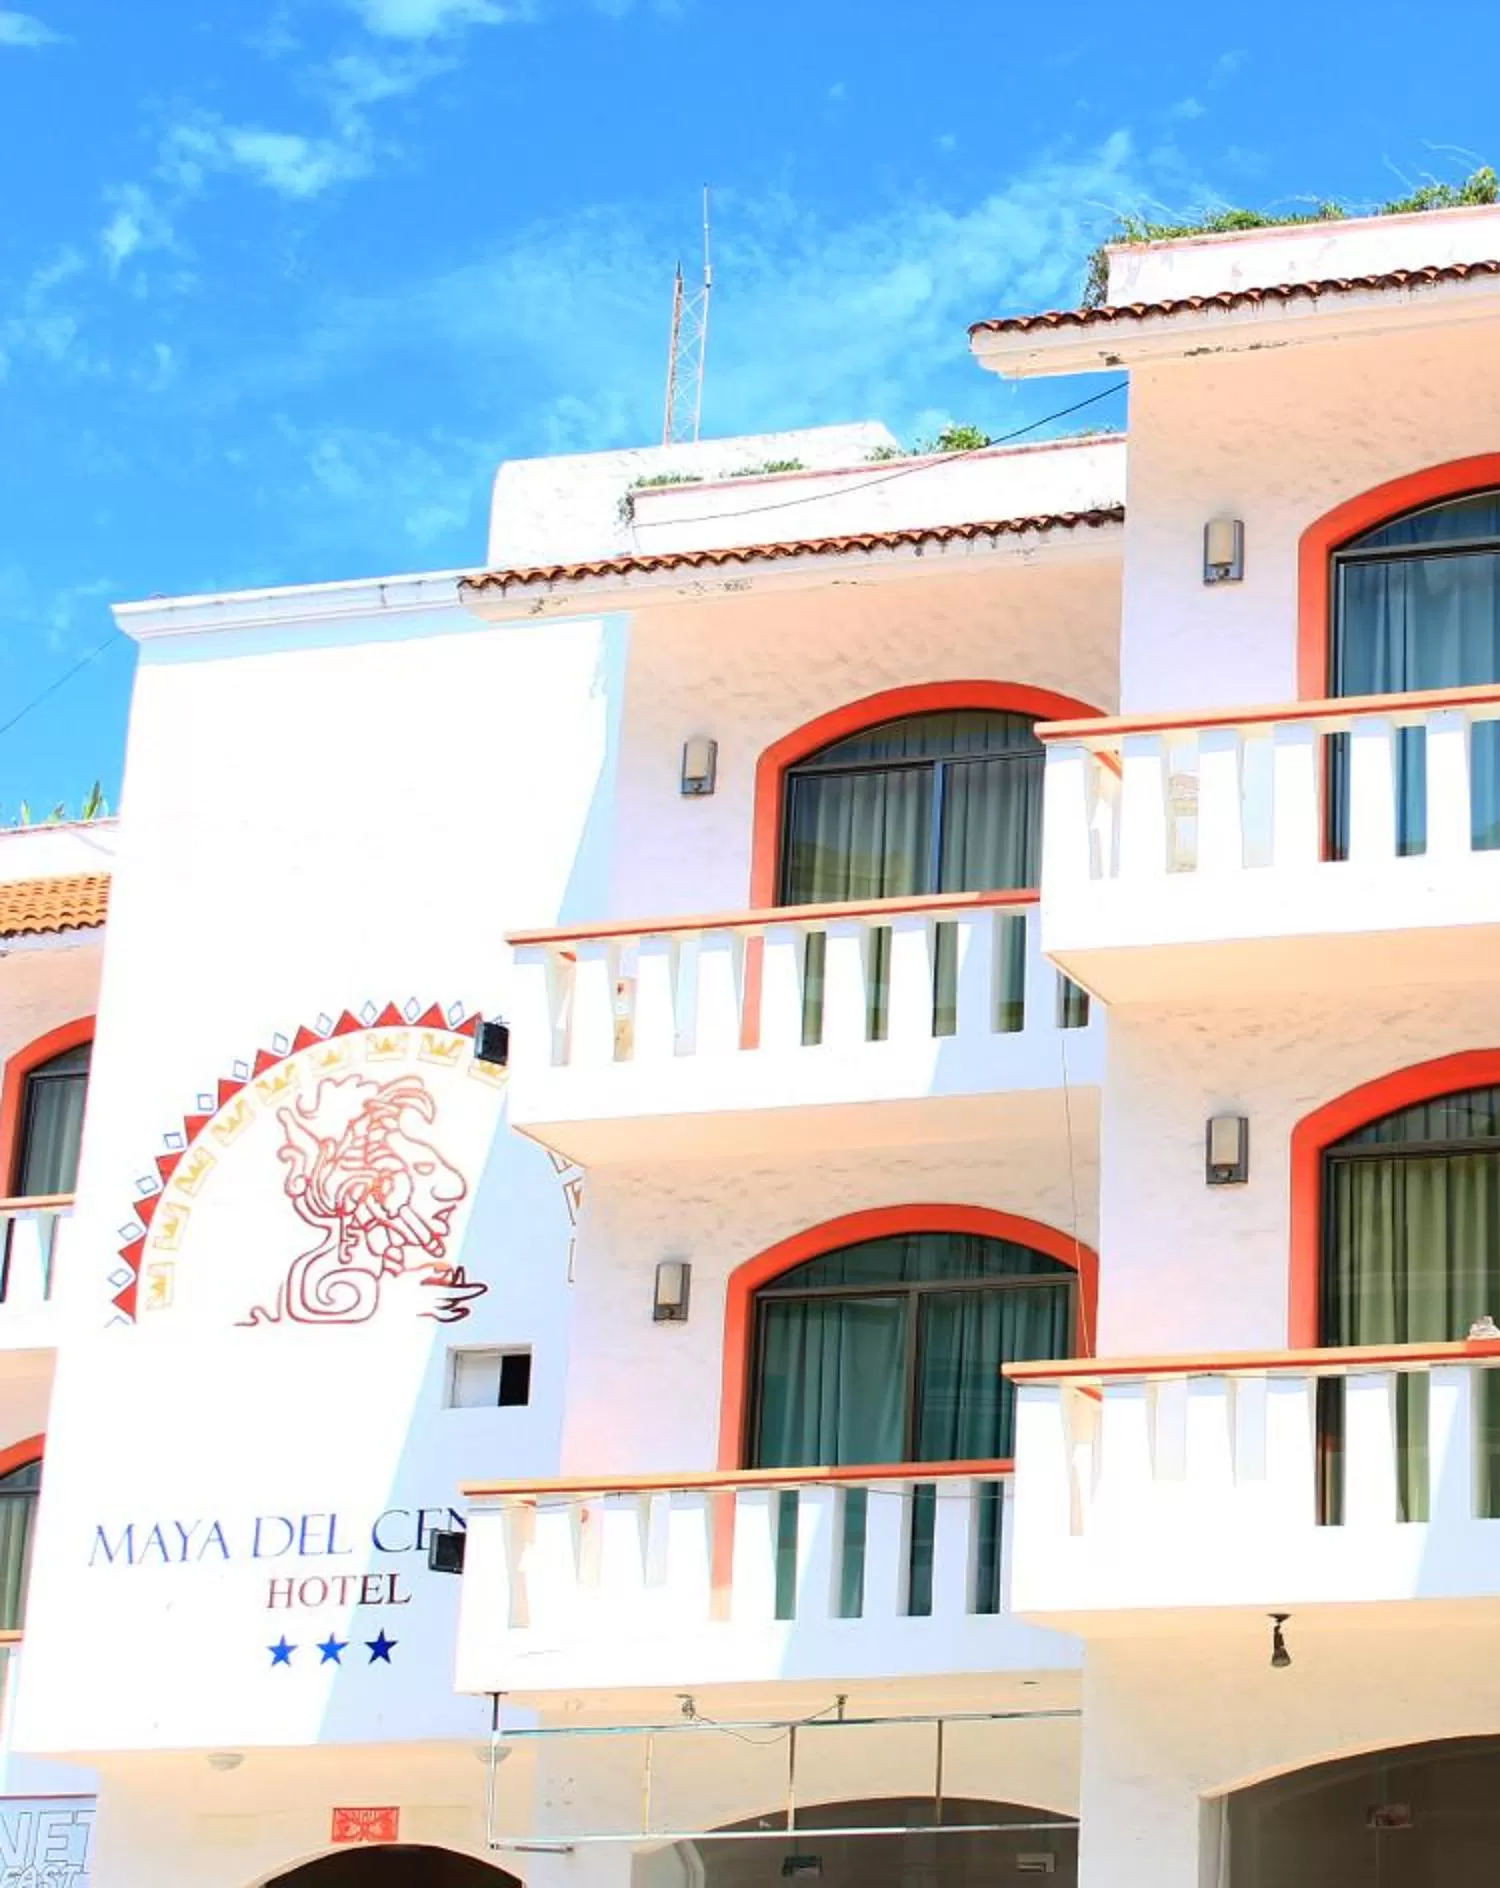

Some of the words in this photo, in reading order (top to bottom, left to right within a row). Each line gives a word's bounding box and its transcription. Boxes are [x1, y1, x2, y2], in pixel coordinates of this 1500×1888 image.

[88, 1520, 230, 1567] MAYA
[252, 1513, 353, 1560] DEL
[371, 1507, 467, 1552] CE
[266, 1573, 412, 1609] HOTEL
